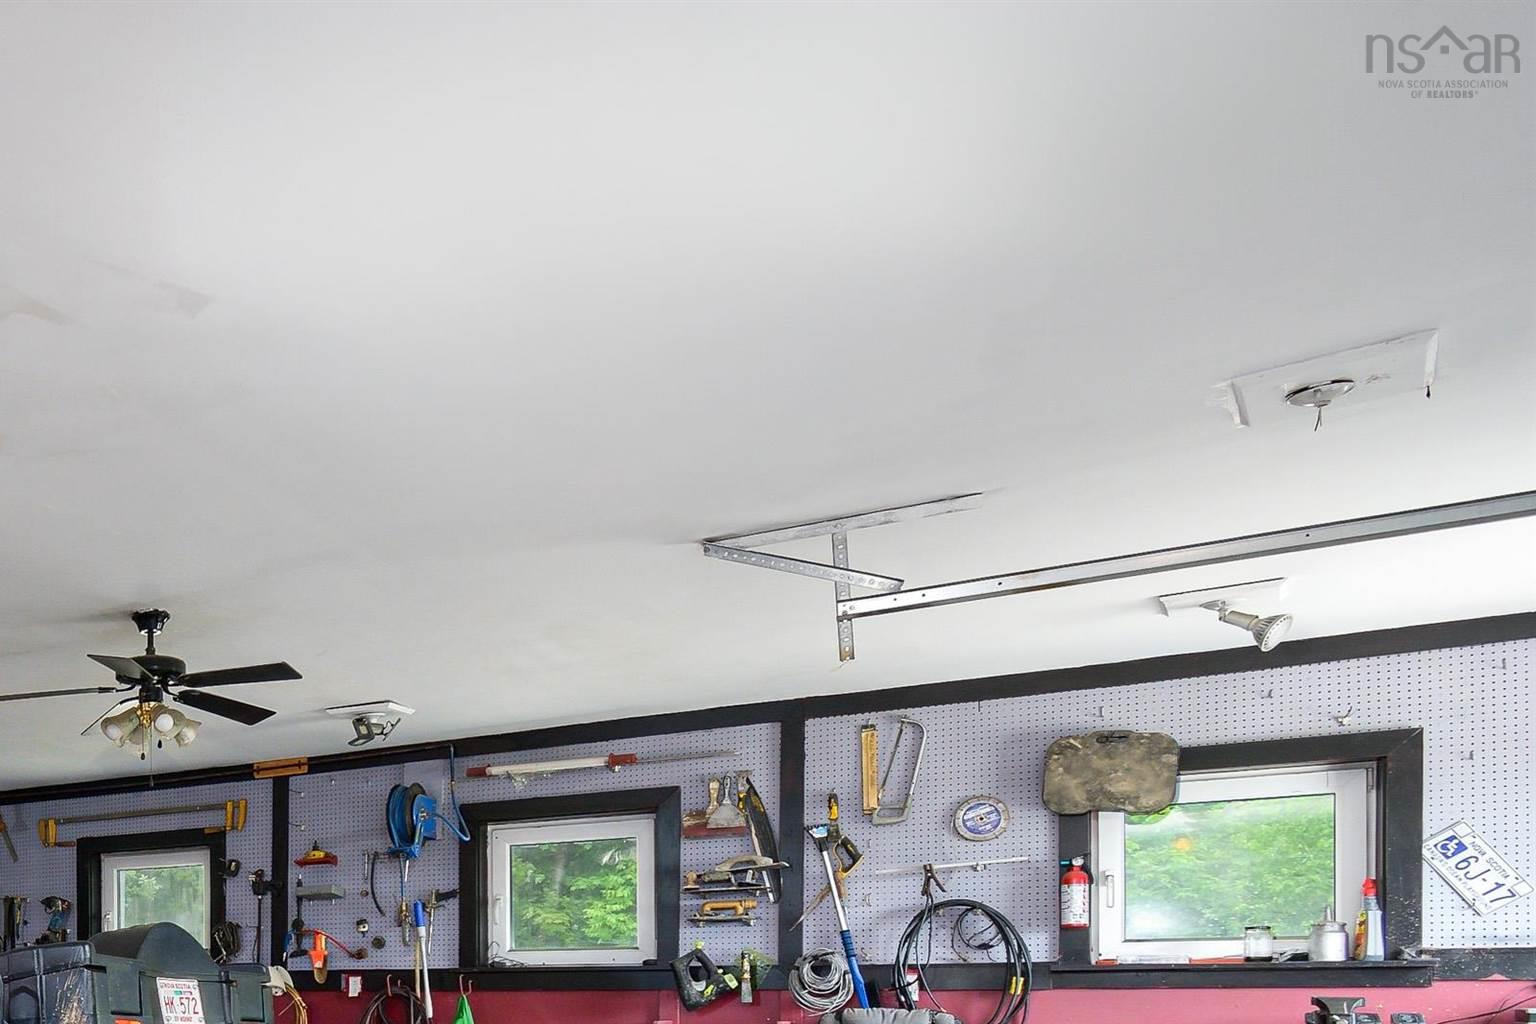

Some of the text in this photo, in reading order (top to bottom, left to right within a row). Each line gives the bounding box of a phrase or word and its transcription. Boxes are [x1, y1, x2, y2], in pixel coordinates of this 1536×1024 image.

[1455, 855, 1517, 903] 6J-17
[1468, 841, 1511, 879] NOVA SCOTIA
